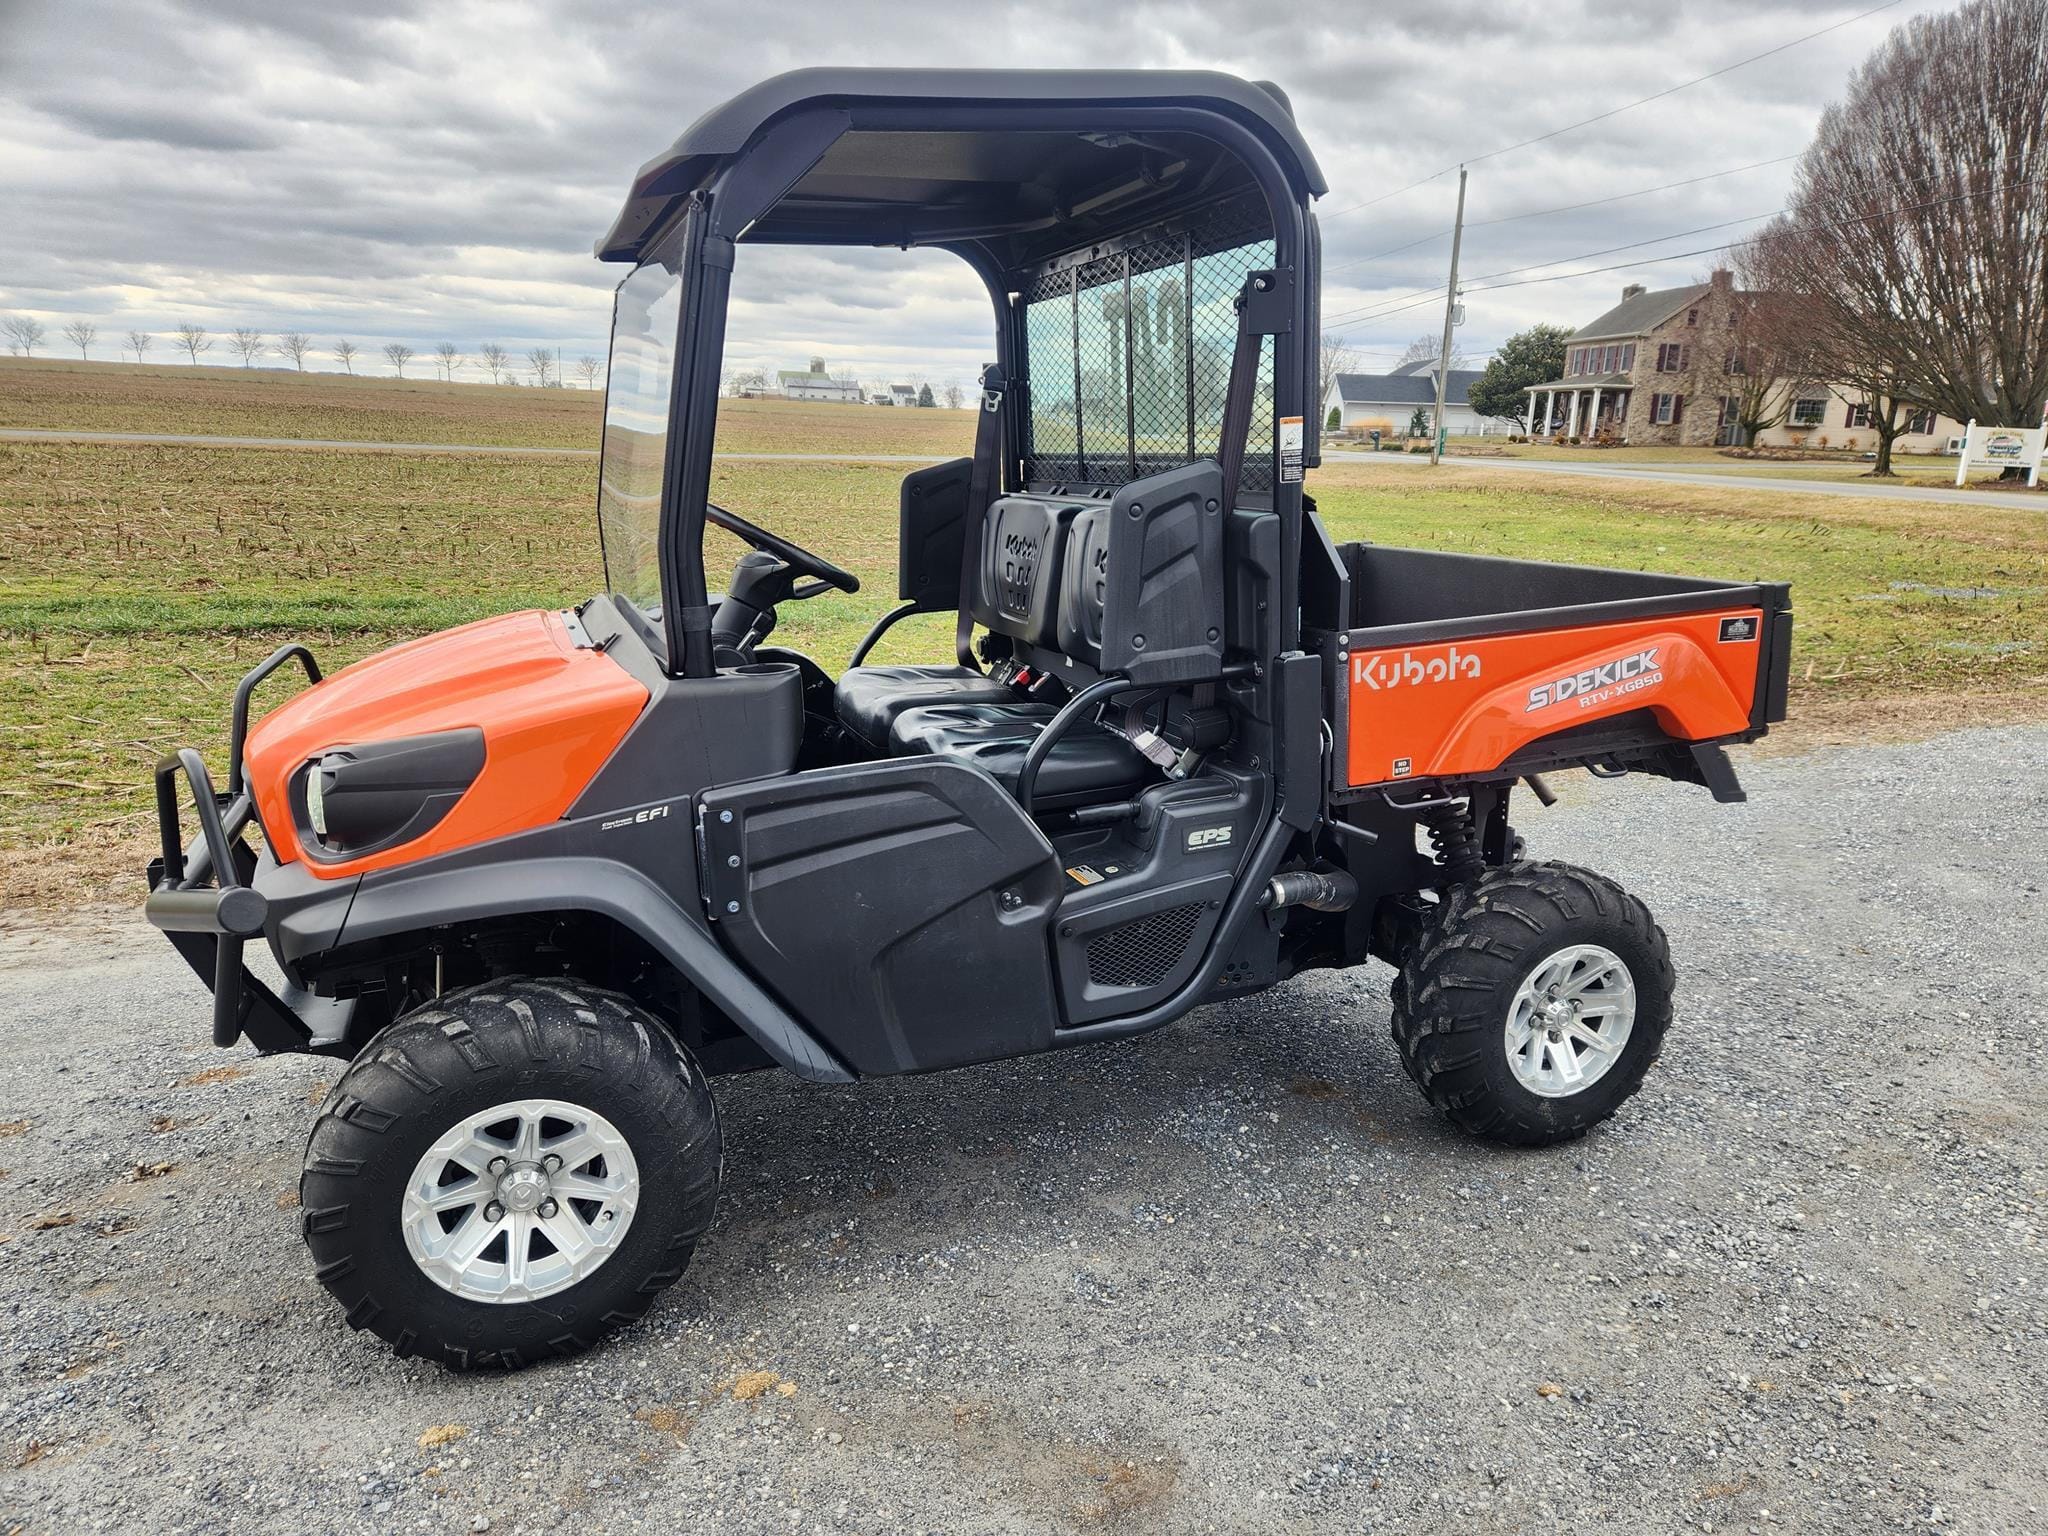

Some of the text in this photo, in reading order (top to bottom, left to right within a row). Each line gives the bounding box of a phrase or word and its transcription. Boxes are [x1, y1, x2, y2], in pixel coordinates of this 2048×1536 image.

[1354, 647, 1481, 690] Kubota
[1524, 647, 1661, 713] SIDEKICK
[1579, 672, 1663, 708] RTV-XG850
[1395, 766, 1409, 774] STEP
[635, 805, 669, 823] EFI
[1188, 825, 1233, 845] EPS
